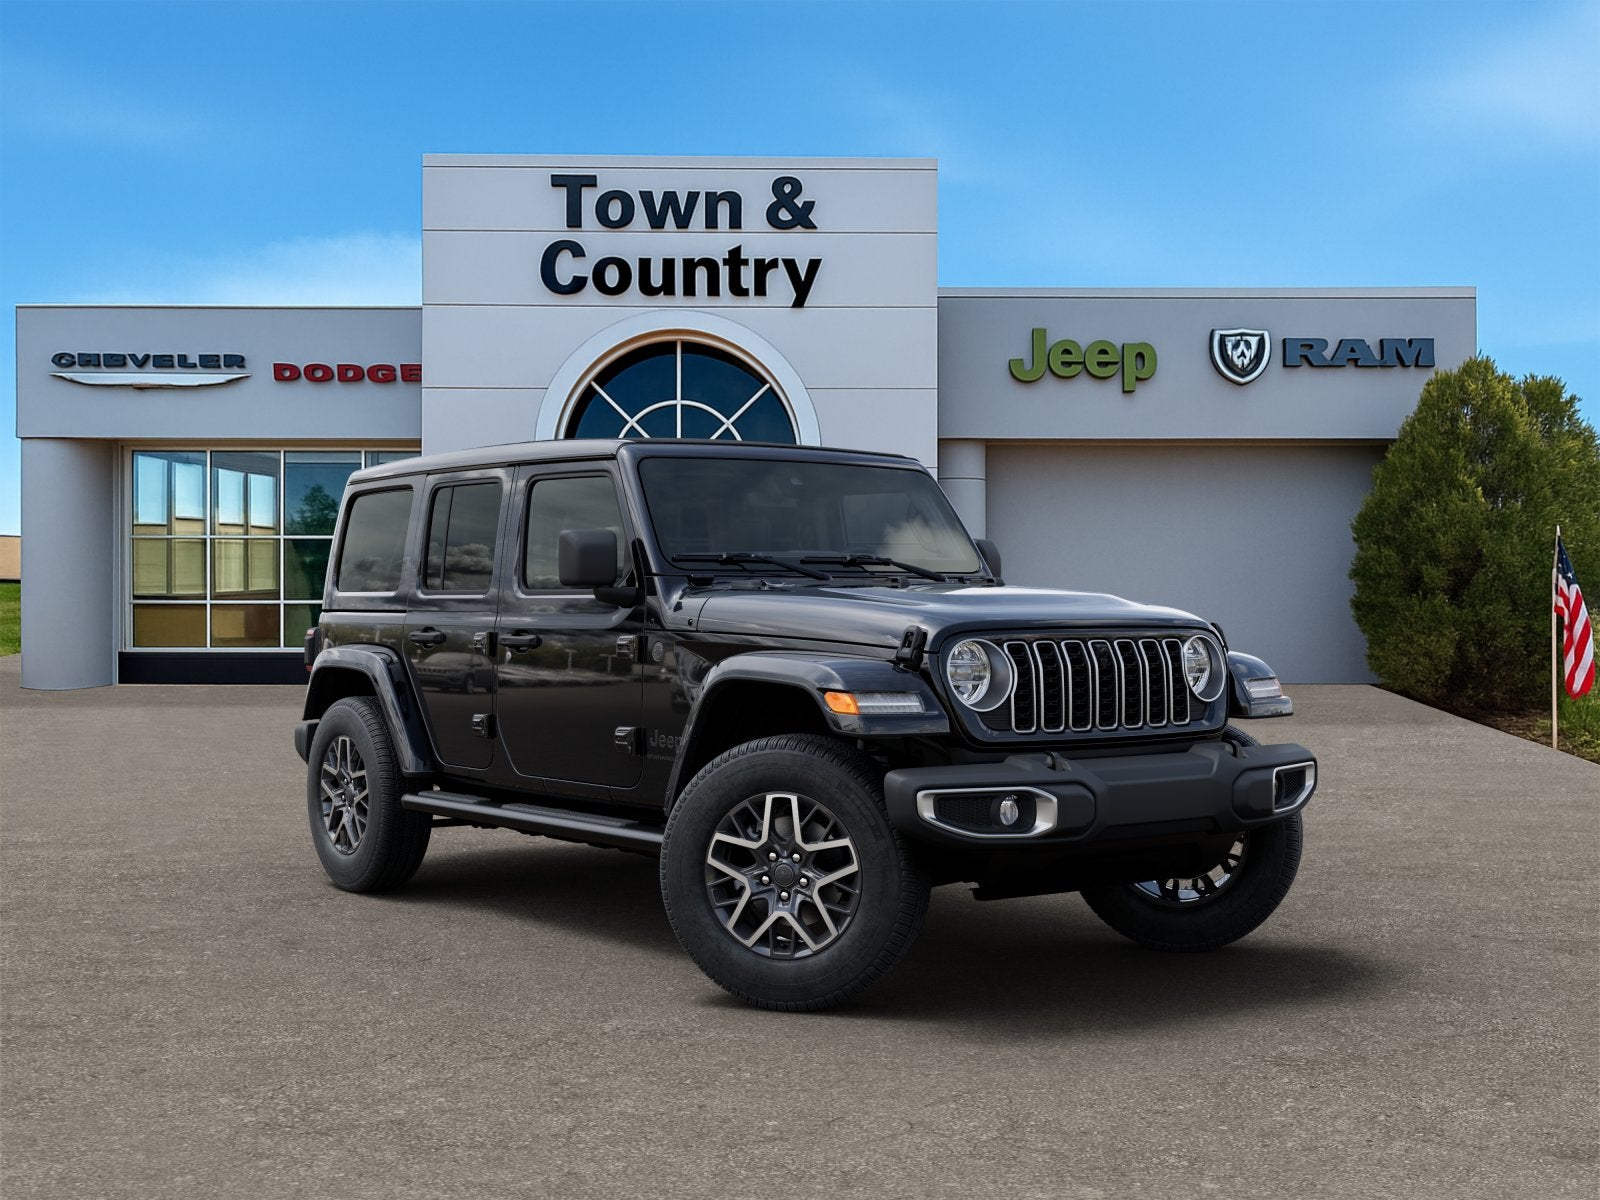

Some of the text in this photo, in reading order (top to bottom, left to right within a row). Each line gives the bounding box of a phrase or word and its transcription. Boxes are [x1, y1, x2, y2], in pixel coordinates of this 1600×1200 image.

[551, 174, 818, 230] Town &
[540, 240, 823, 308] Country
[273, 362, 422, 383] DODGE
[1008, 328, 1158, 393] Jeep
[1282, 337, 1435, 368] RAM
